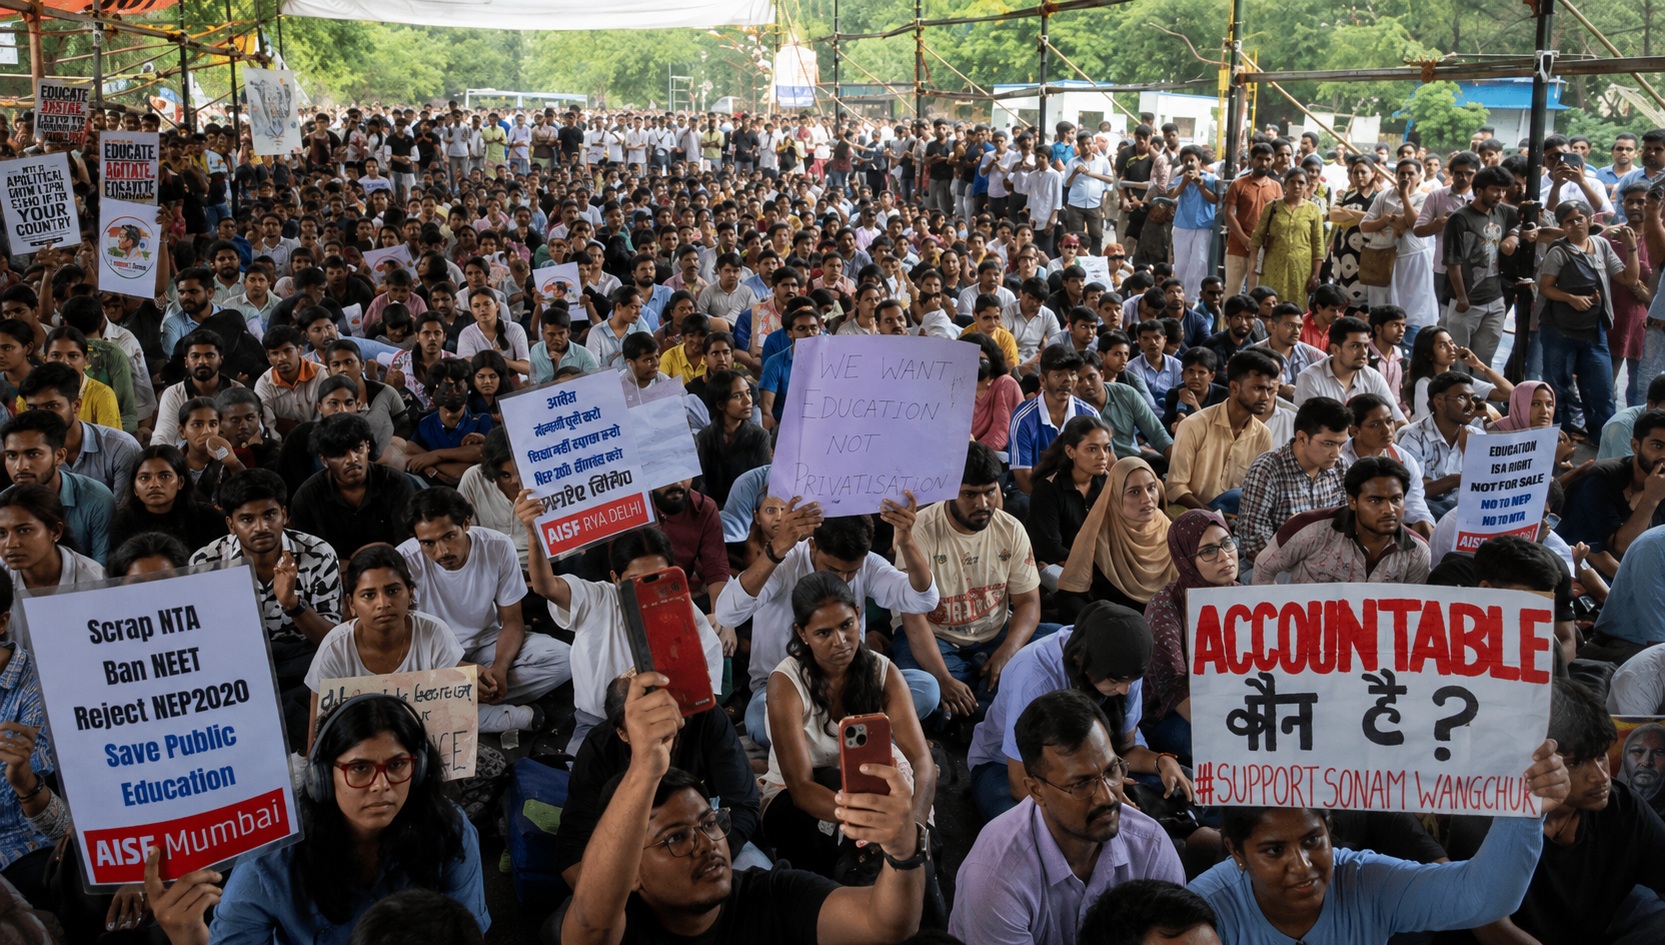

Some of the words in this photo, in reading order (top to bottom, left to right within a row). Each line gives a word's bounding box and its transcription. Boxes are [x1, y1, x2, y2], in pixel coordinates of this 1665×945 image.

[16, 216, 71, 236] COUNTRY
[17, 203, 67, 222] YOUR
[820, 353, 862, 379] WE
[882, 357, 953, 380] WANT
[801, 389, 940, 420] EDUCATION
[826, 434, 881, 455] NOT
[1489, 440, 1537, 457] EDUCATION
[534, 470, 553, 486] NEP
[794, 462, 949, 496] PRIVATISATION
[1491, 464, 1500, 474] IS
[1500, 464, 1506, 473] A
[1508, 458, 1533, 473] RIGHT
[1470, 482, 1497, 492] NOT
[1498, 479, 1518, 491] FOR
[1519, 473, 1544, 487] SALE
[1480, 499, 1497, 509] NO
[1499, 498, 1510, 508] TO
[1511, 493, 1531, 506] NEP
[548, 519, 580, 545] AISF
[583, 511, 608, 531] RYA
[608, 500, 642, 523] DELHI
[1481, 516, 1496, 526] NO
[1498, 514, 1508, 525] TO
[1508, 510, 1526, 524] NTA
[87, 615, 154, 645] Scrap
[158, 605, 201, 634] NTA
[1193, 598, 1552, 684] ACCOUNTABLE
[103, 658, 147, 685] Ban
[151, 647, 201, 678] NEET
[73, 698, 149, 731] Reject
[151, 679, 250, 720] NEP2020
[1226, 671, 1319, 752] कौन
[1361, 668, 1408, 746] है
[1432, 685, 1479, 762] ?
[104, 740, 160, 768] Save
[164, 724, 237, 759] Public
[121, 765, 236, 807] Education
[1195, 762, 1319, 806] #SUPPORT
[1323, 767, 1406, 811] SONAM
[96, 835, 155, 867] AISF
[165, 799, 280, 860] Mumbai
